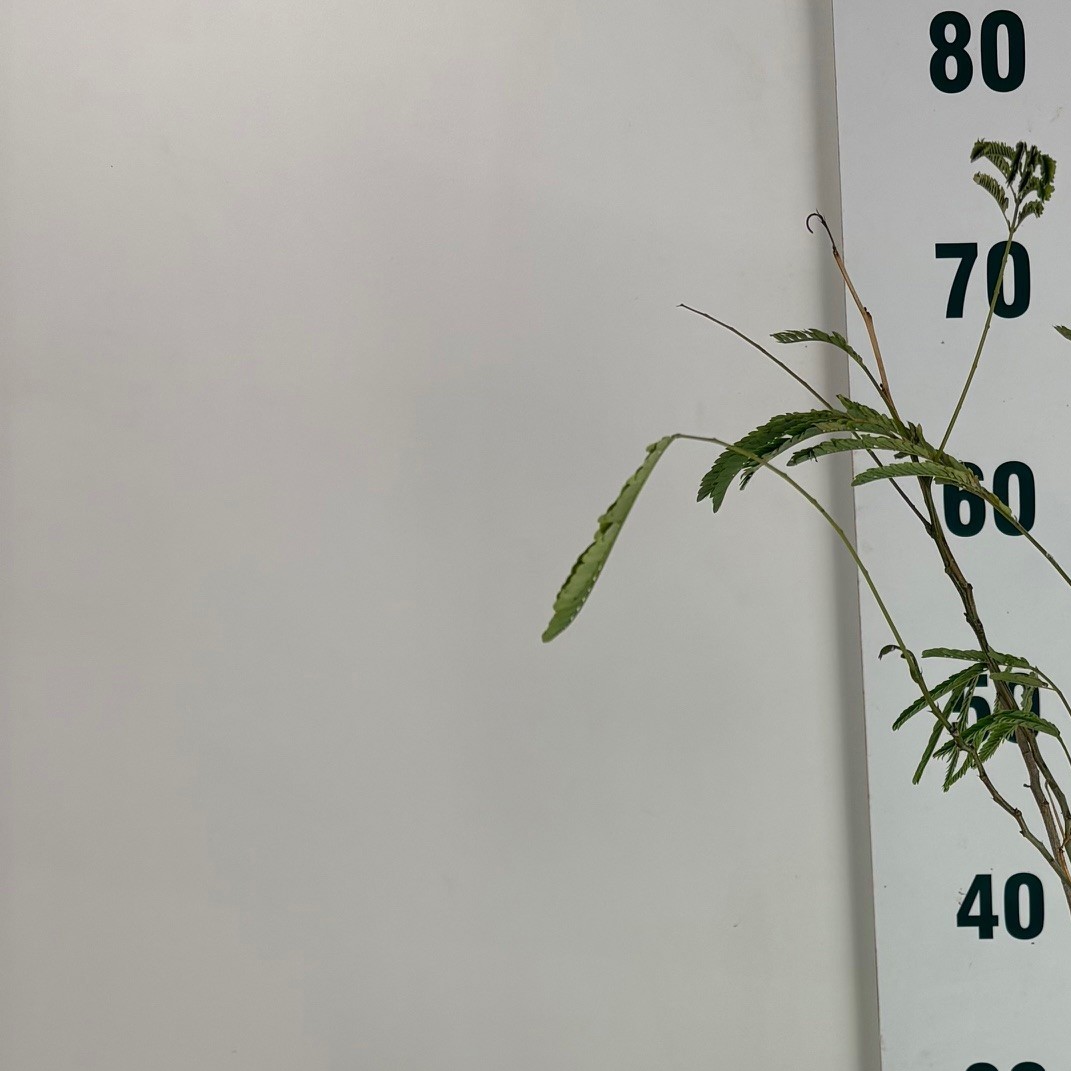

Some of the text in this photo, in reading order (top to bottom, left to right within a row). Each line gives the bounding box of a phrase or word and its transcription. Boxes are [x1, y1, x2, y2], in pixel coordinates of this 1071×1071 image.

[929, 10, 1026, 94] 80
[935, 240, 1031, 319] 70
[943, 461, 1036, 537] 60
[956, 873, 1045, 940] 40
